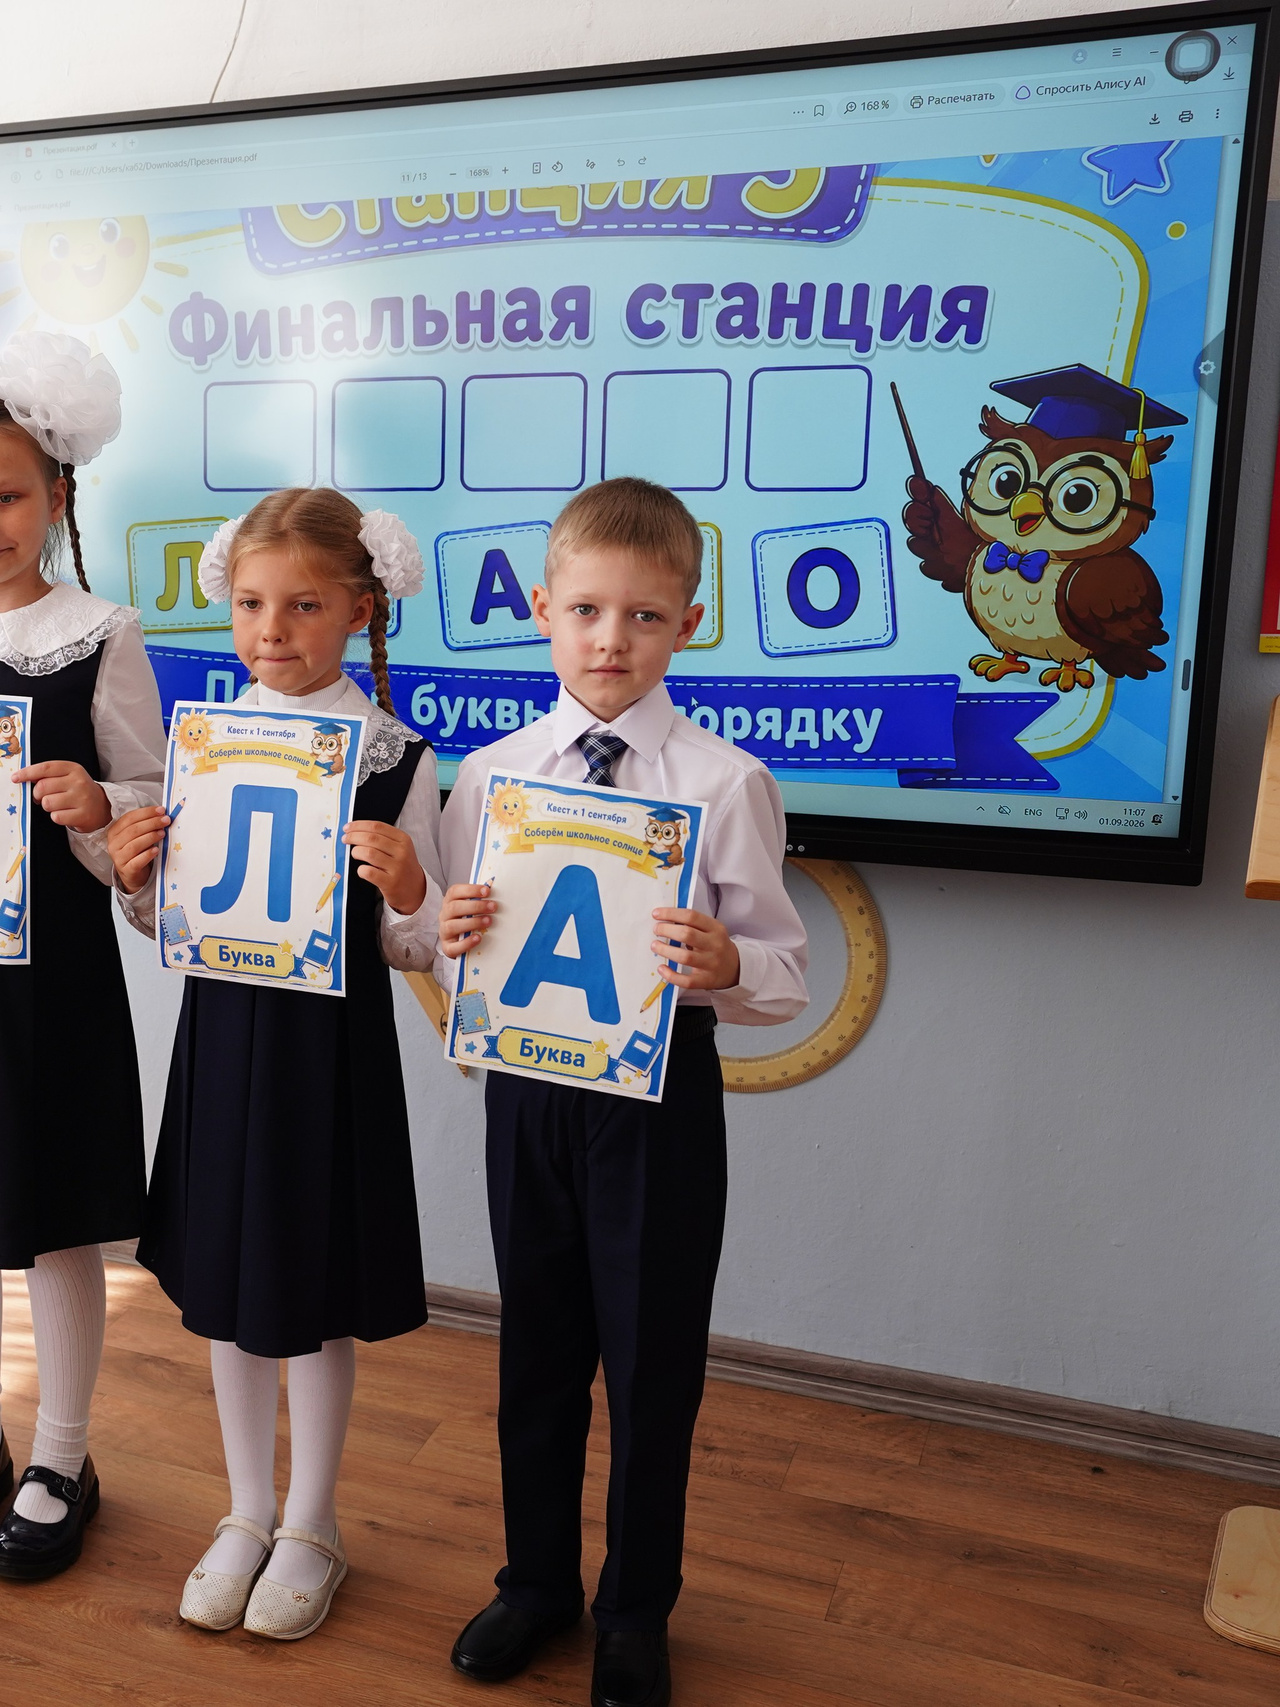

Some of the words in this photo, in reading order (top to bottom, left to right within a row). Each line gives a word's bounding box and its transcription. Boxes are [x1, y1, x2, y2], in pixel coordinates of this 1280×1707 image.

[927, 90, 995, 107] Распечатать
[1035, 82, 1091, 98] Спросить
[1094, 77, 1131, 93] Алису
[1133, 75, 1146, 88] AI
[469, 168, 490, 177] 168%
[169, 284, 592, 366] Финальная
[625, 281, 989, 353] станция
[156, 541, 208, 612] Л
[470, 548, 532, 625] А
[786, 547, 861, 630] О
[227, 726, 248, 736] Квест
[256, 727, 261, 737] 1
[262, 729, 296, 740] сентября
[674, 705, 883, 754] орядку
[208, 747, 243, 760] Соберём
[244, 748, 282, 760] школьное
[283, 754, 311, 767] солнце
[546, 802, 571, 816] Квест
[580, 807, 586, 817] 1
[587, 810, 628, 825] сентября
[1023, 807, 1043, 818] ENG
[1123, 807, 1146, 818] 11:07
[1098, 817, 1145, 829] 01.09.2026
[200, 784, 299, 923] Л
[524, 827, 564, 840] Соберём
[566, 829, 610, 846] школьное
[612, 838, 644, 857] солнце
[218, 944, 276, 969] Буква
[499, 864, 621, 1026] А
[520, 1037, 586, 1068] Буква
